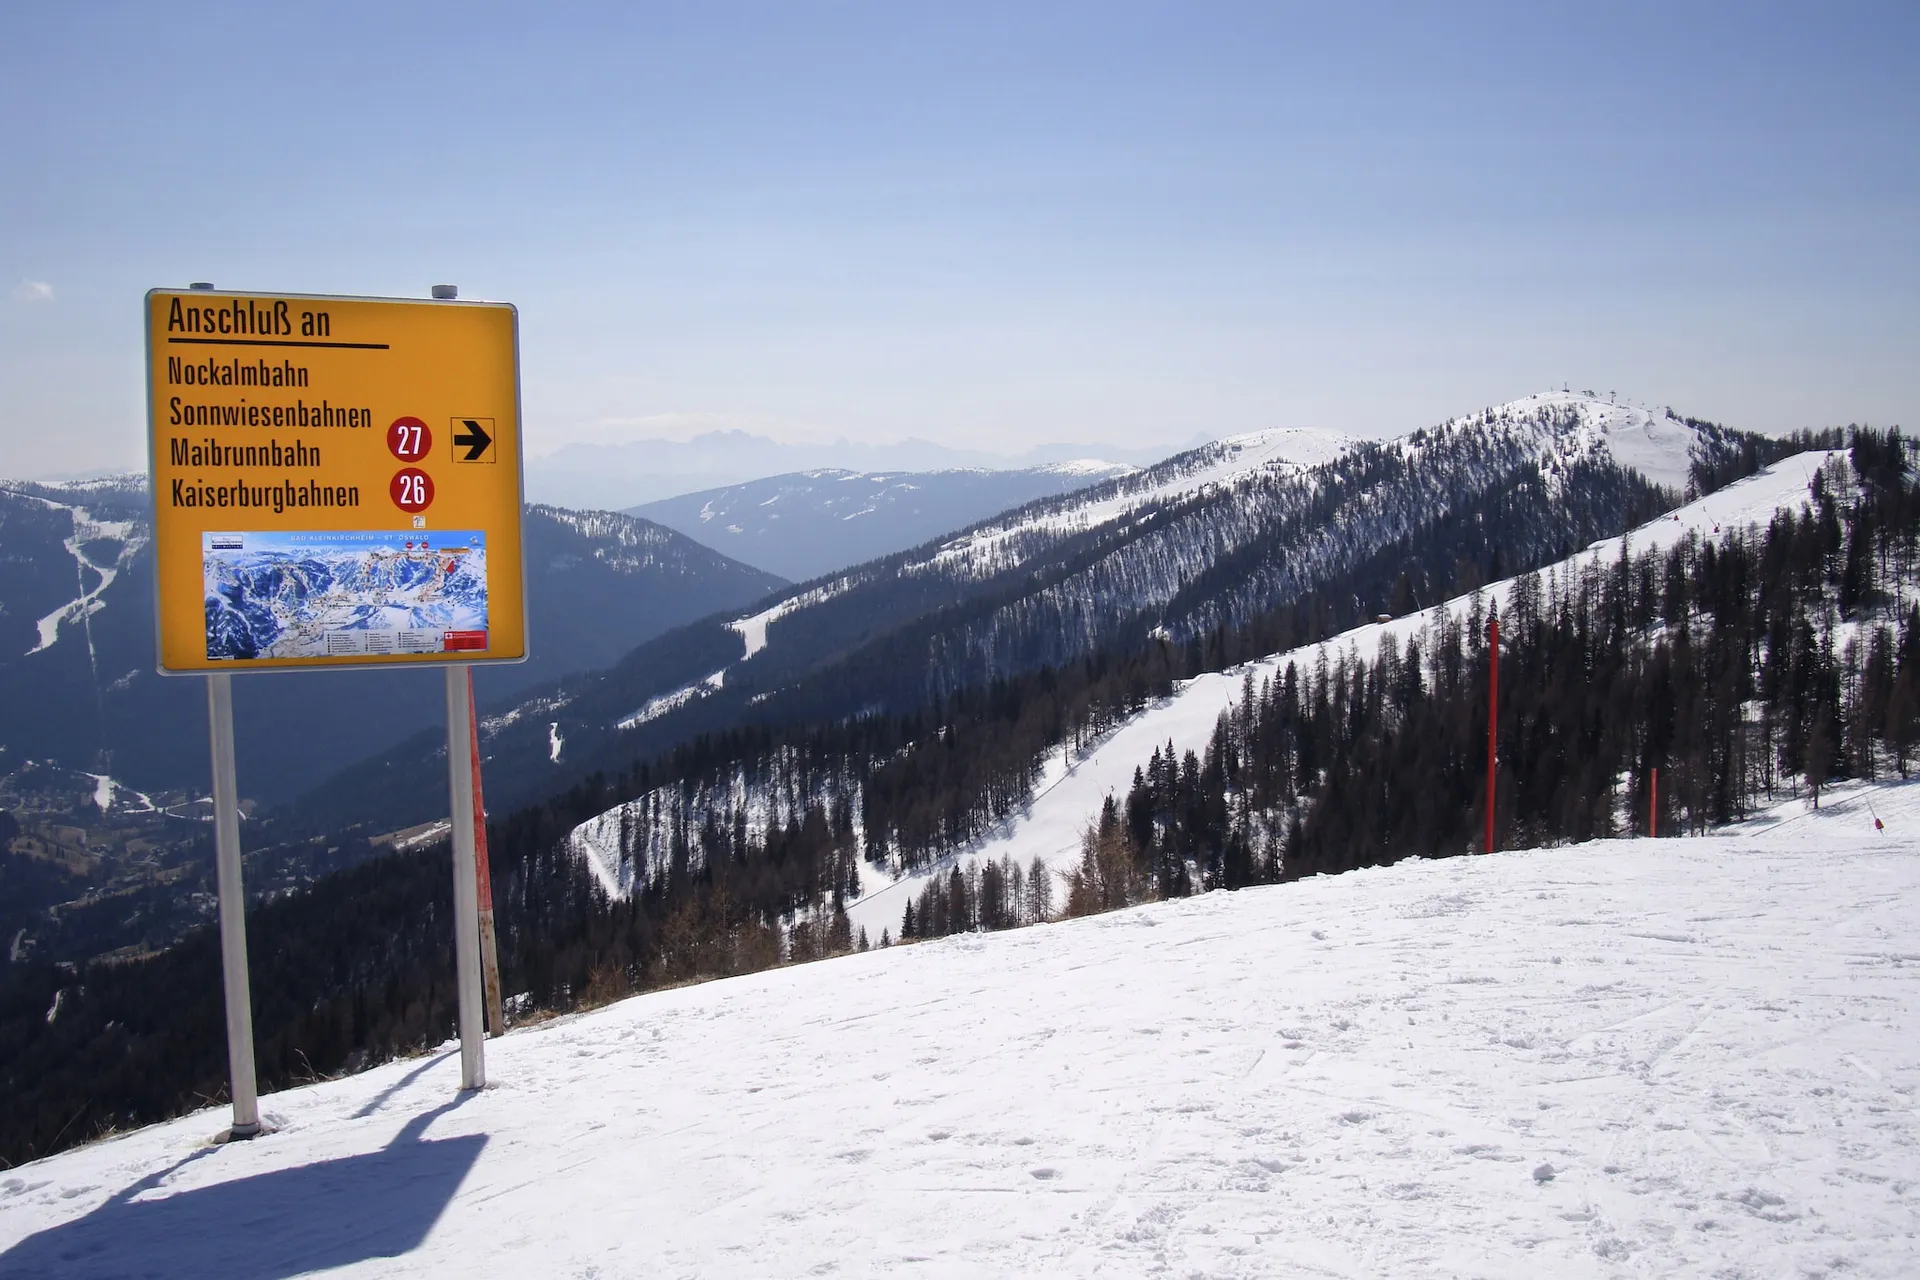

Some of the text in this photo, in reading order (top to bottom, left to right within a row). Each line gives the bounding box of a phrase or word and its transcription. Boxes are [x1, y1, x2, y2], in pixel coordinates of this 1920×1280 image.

[167, 297, 330, 337] Anschluß an
[168, 356, 309, 388] Nockalmbahn
[169, 396, 371, 428] Sonnwiesenbahnen
[170, 437, 321, 467] Maibrunnbahn
[397, 426, 422, 455] 27
[171, 478, 359, 514] Kaiserburgbahnen
[400, 475, 425, 505] 26
